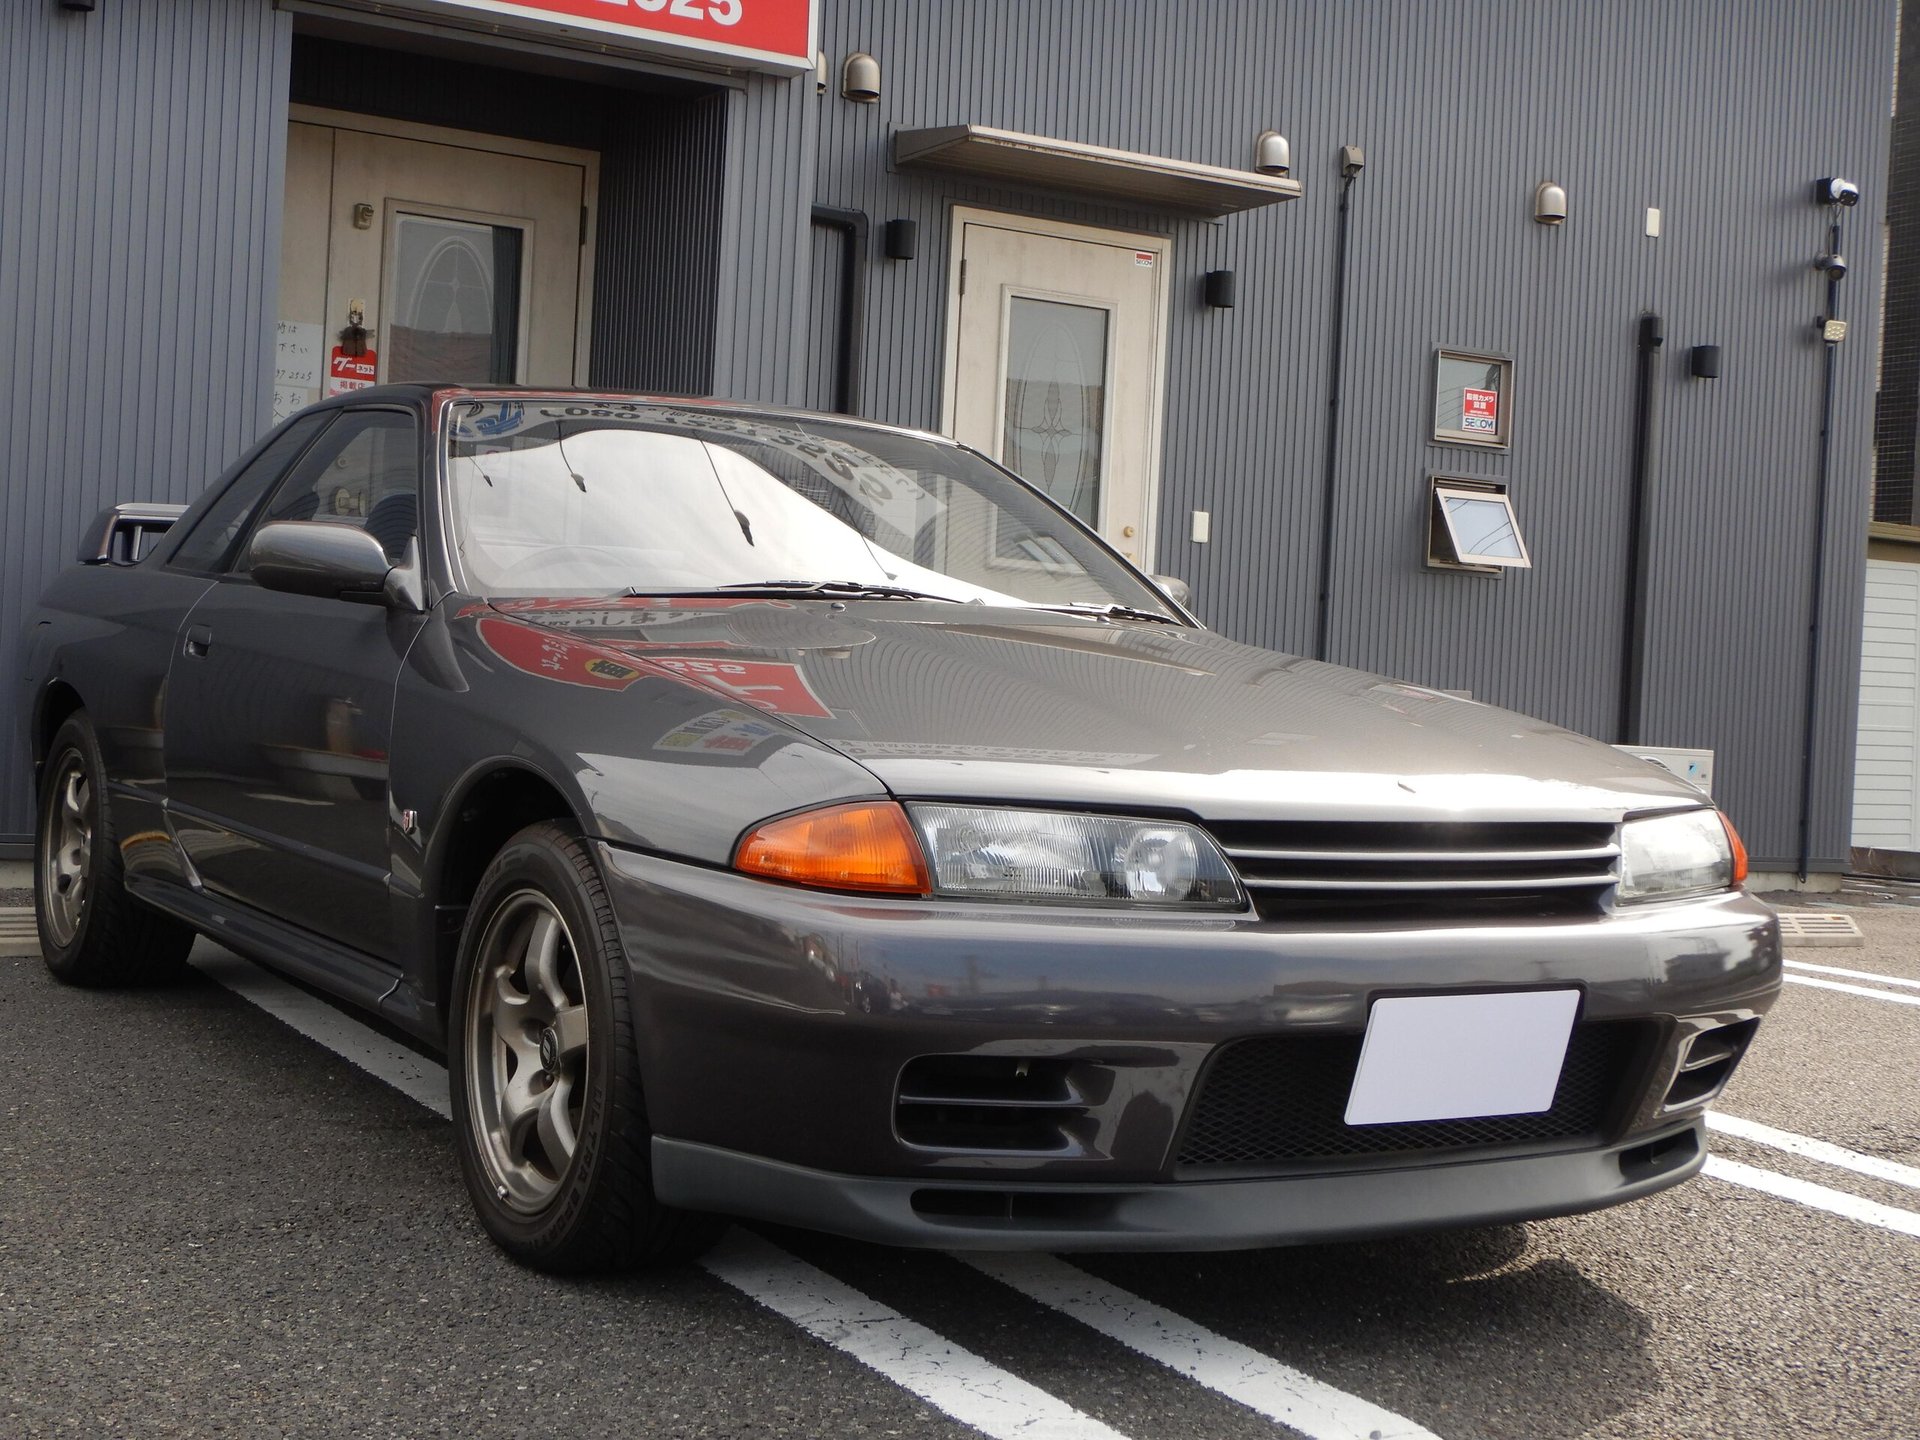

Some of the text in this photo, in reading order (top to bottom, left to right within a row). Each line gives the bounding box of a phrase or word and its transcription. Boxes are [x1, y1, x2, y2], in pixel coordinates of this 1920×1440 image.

[279, 343, 309, 354] 下さい
[1465, 418, 1493, 429] SECOM
